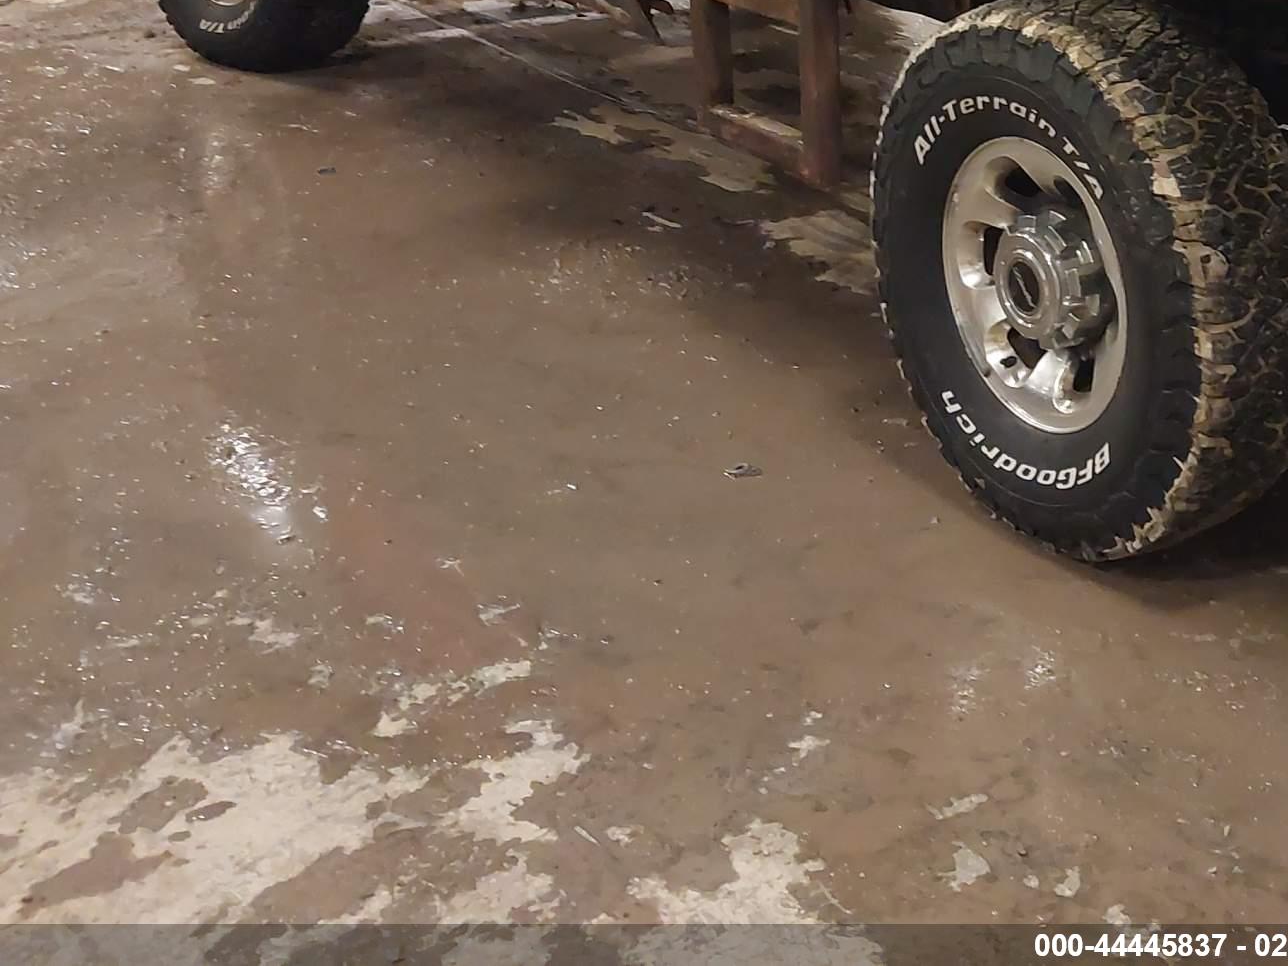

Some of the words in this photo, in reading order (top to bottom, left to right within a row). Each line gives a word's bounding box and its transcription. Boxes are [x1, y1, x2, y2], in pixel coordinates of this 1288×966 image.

[914, 95, 1057, 165] All-Terrain
[1062, 136, 1104, 200] T/A
[941, 390, 1112, 490] BFGoodrich
